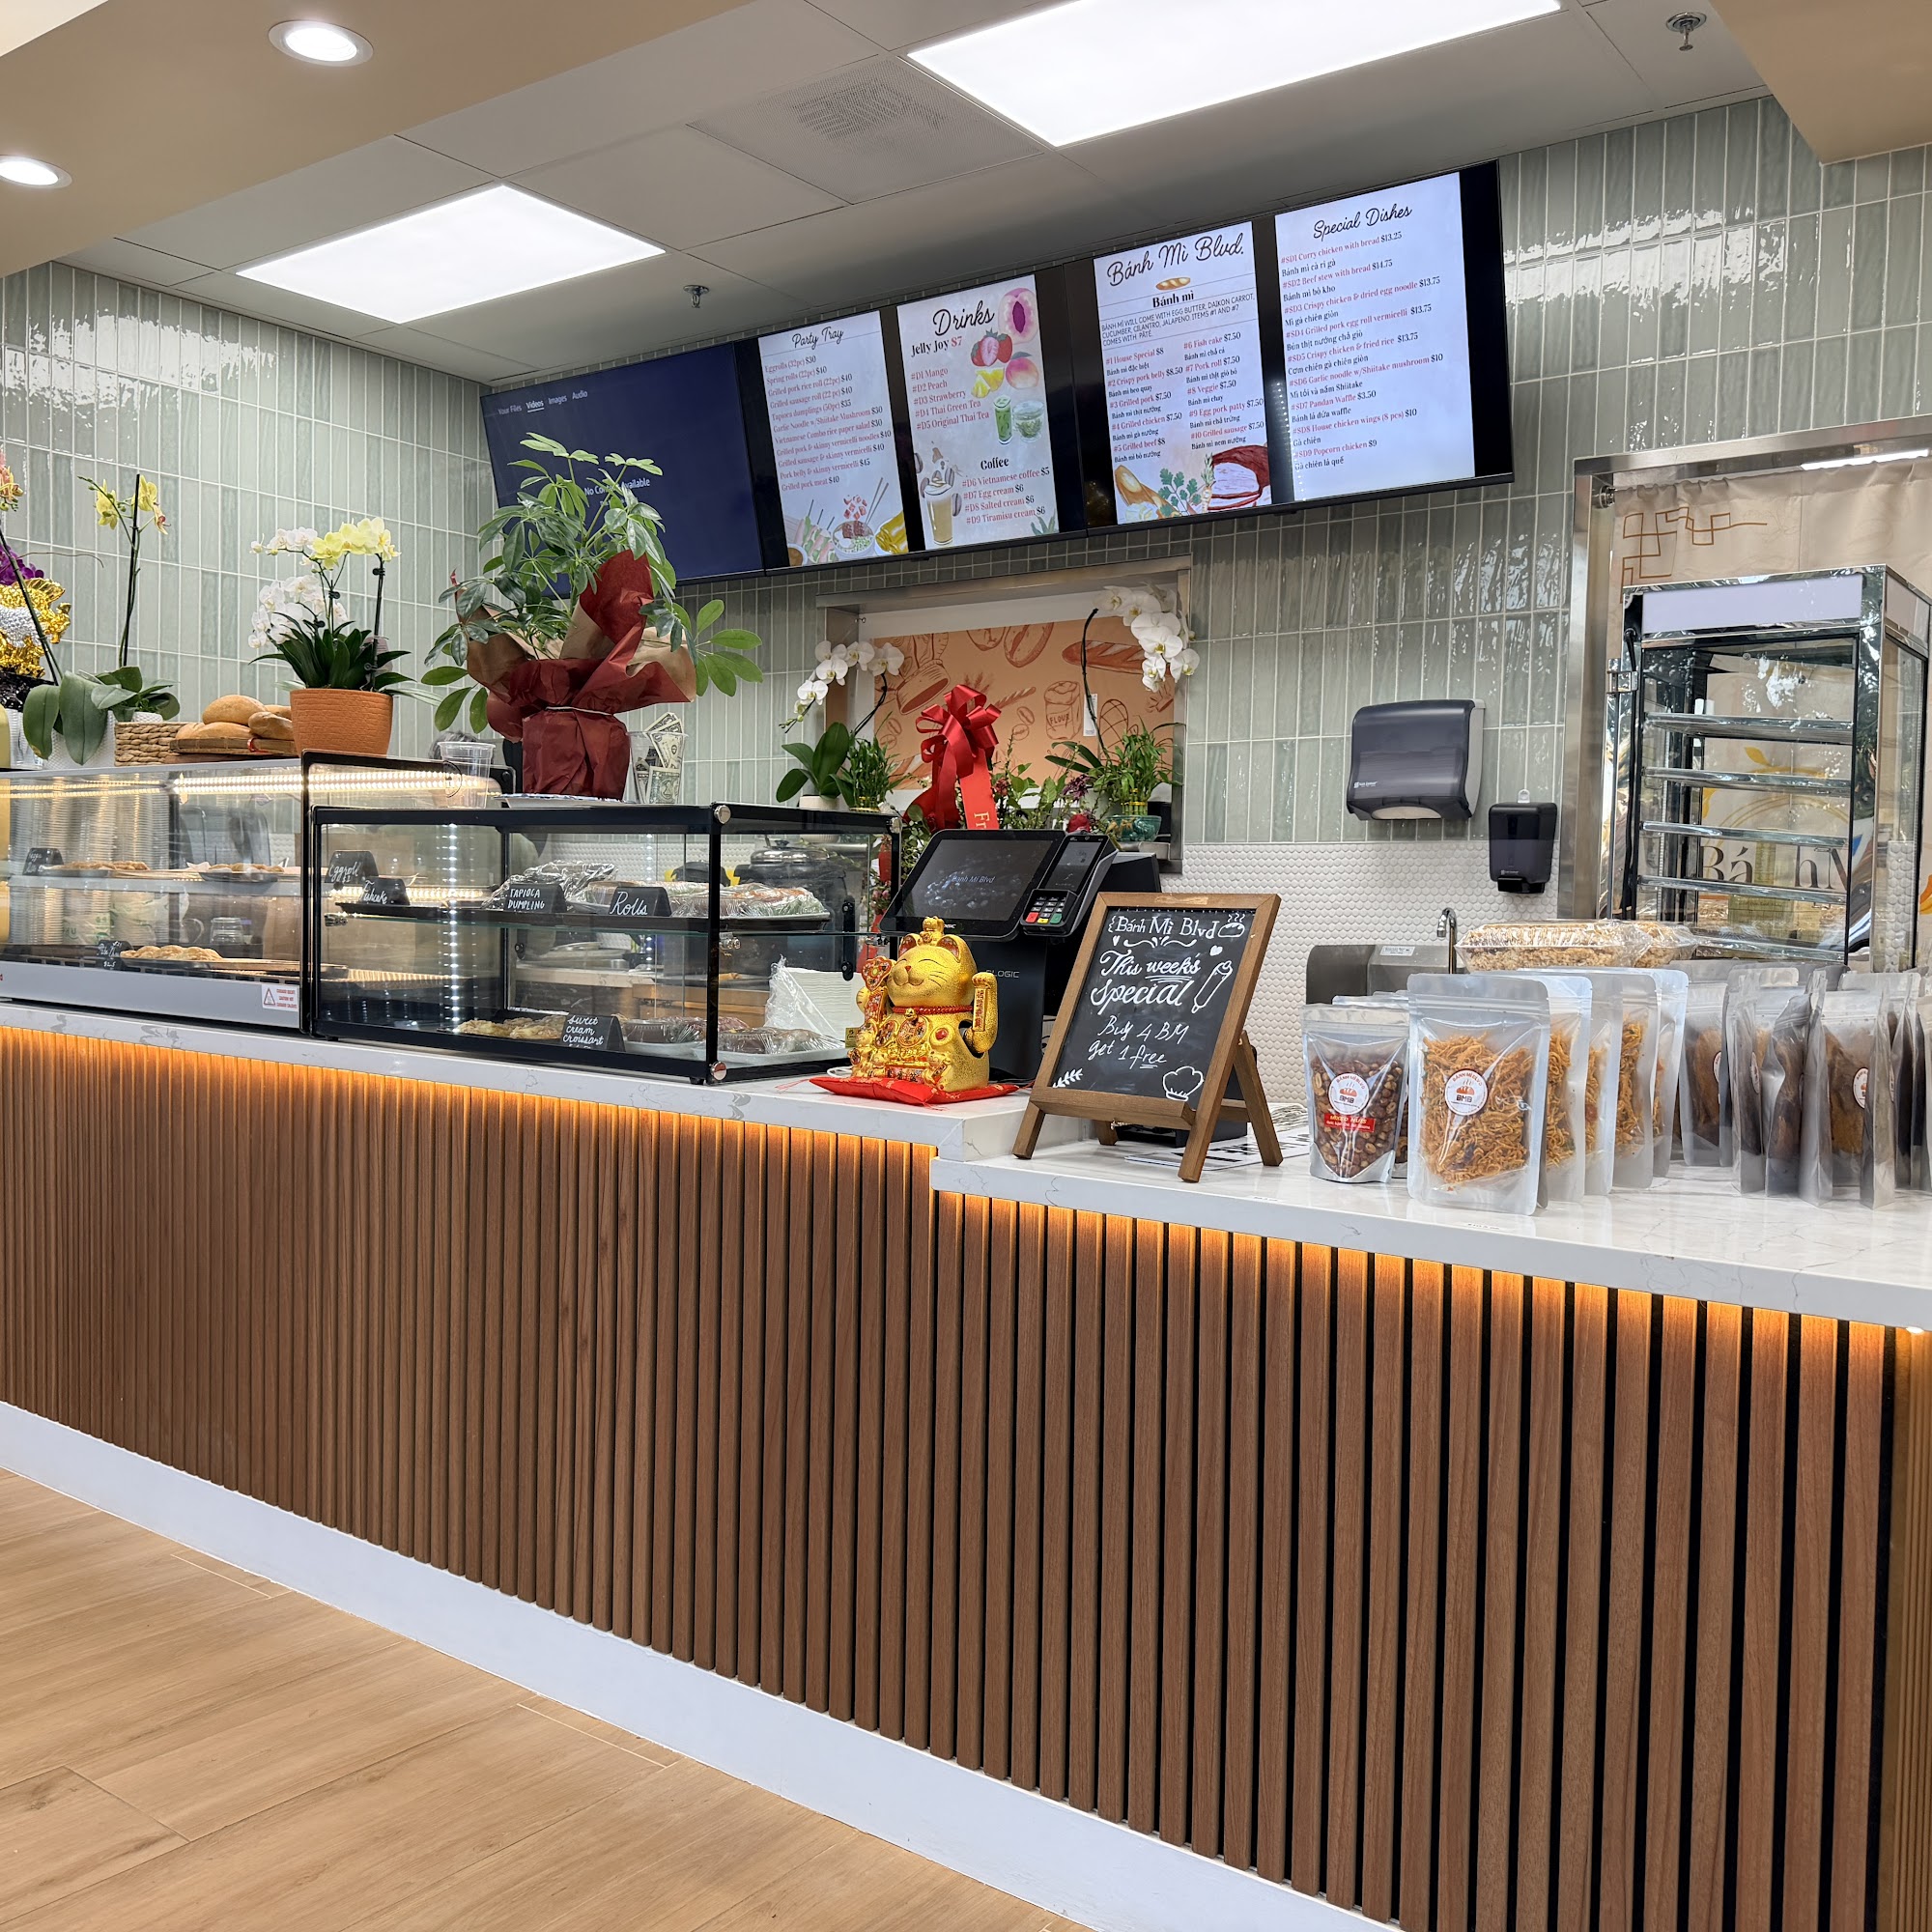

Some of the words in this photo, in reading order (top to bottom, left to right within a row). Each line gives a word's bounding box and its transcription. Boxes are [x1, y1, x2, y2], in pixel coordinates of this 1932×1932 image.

[1313, 211, 1361, 242] Special
[1366, 203, 1412, 228] Dishes
[1297, 251, 1316, 260] Curry
[1318, 245, 1343, 256] chicken
[1344, 241, 1359, 249] with
[1360, 236, 1379, 246] bread
[1380, 231, 1402, 242] $13.25
[1106, 250, 1153, 286] Bánh
[1157, 242, 1188, 268] Mì
[1301, 274, 1317, 285] Beef
[1334, 268, 1350, 277] with
[1350, 263, 1371, 274] bread
[1372, 258, 1392, 270] $14.75
[1152, 293, 1179, 307] Bánh
[932, 299, 995, 336] Drinks
[1138, 313, 1154, 324] COME
[1154, 310, 1171, 319] WITH
[1171, 307, 1183, 316] EGG
[791, 331, 818, 350] Party
[821, 326, 843, 344] Tray
[1193, 338, 1207, 348] Fish
[1208, 336, 1222, 345] cake
[911, 342, 931, 357] Jelly
[933, 339, 949, 353] Joy
[924, 368, 948, 377] Mango
[1194, 361, 1209, 371] Pork
[1210, 358, 1222, 367] roll
[1308, 374, 1328, 384] Garlic
[1329, 369, 1351, 380] noodle
[1391, 357, 1430, 369] mushroom
[1431, 353, 1443, 362] $10
[912, 383, 926, 392] #D2
[927, 379, 947, 390] Peach
[526, 400, 544, 409] Videos
[548, 395, 568, 405] Images
[572, 390, 587, 400] Audio
[913, 395, 927, 405] #D3
[928, 390, 965, 403] Strawberry
[1334, 393, 1355, 402] Waffle
[1356, 389, 1376, 400] $3.50
[929, 405, 946, 414] Thai
[947, 403, 967, 412] Green
[969, 399, 980, 408] Tea
[1199, 408, 1211, 416] Egg
[1212, 404, 1227, 415] pork
[1229, 402, 1244, 412] patty
[931, 414, 958, 428] Original
[959, 412, 976, 422] Thai
[976, 411, 989, 419] Tea
[1312, 423, 1332, 432] House
[1333, 418, 1358, 428] chicken
[1405, 408, 1417, 416] $10
[980, 456, 1009, 469] Coffee
[1018, 469, 1039, 479] coffee
[583, 487, 594, 496] No
[978, 490, 991, 498] Egg
[992, 487, 1014, 496] cream
[1014, 483, 1024, 493] $6
[980, 499, 1002, 510] Salted
[1003, 497, 1024, 506] cream
[1025, 495, 1034, 503] $6
[981, 511, 1012, 522] Tiramisu
[1013, 509, 1037, 518] cream
[974, 811, 990, 829] Fr
[510, 889, 541, 897] TAPIOCA
[507, 900, 545, 910] DUMPLING
[609, 891, 648, 916] Rolls
[1115, 916, 1146, 933] Bánh
[1150, 916, 1175, 935] Mì
[1179, 918, 1220, 939] Blvd
[1099, 949, 1142, 976] This
[986, 970, 1020, 979] LOGIC
[1097, 1014, 1134, 1041] Buy
[1136, 1023, 1152, 1041] 4
[1088, 1039, 1115, 1061] get
[1118, 1045, 1130, 1060] 1
[1129, 1044, 1167, 1069] free
